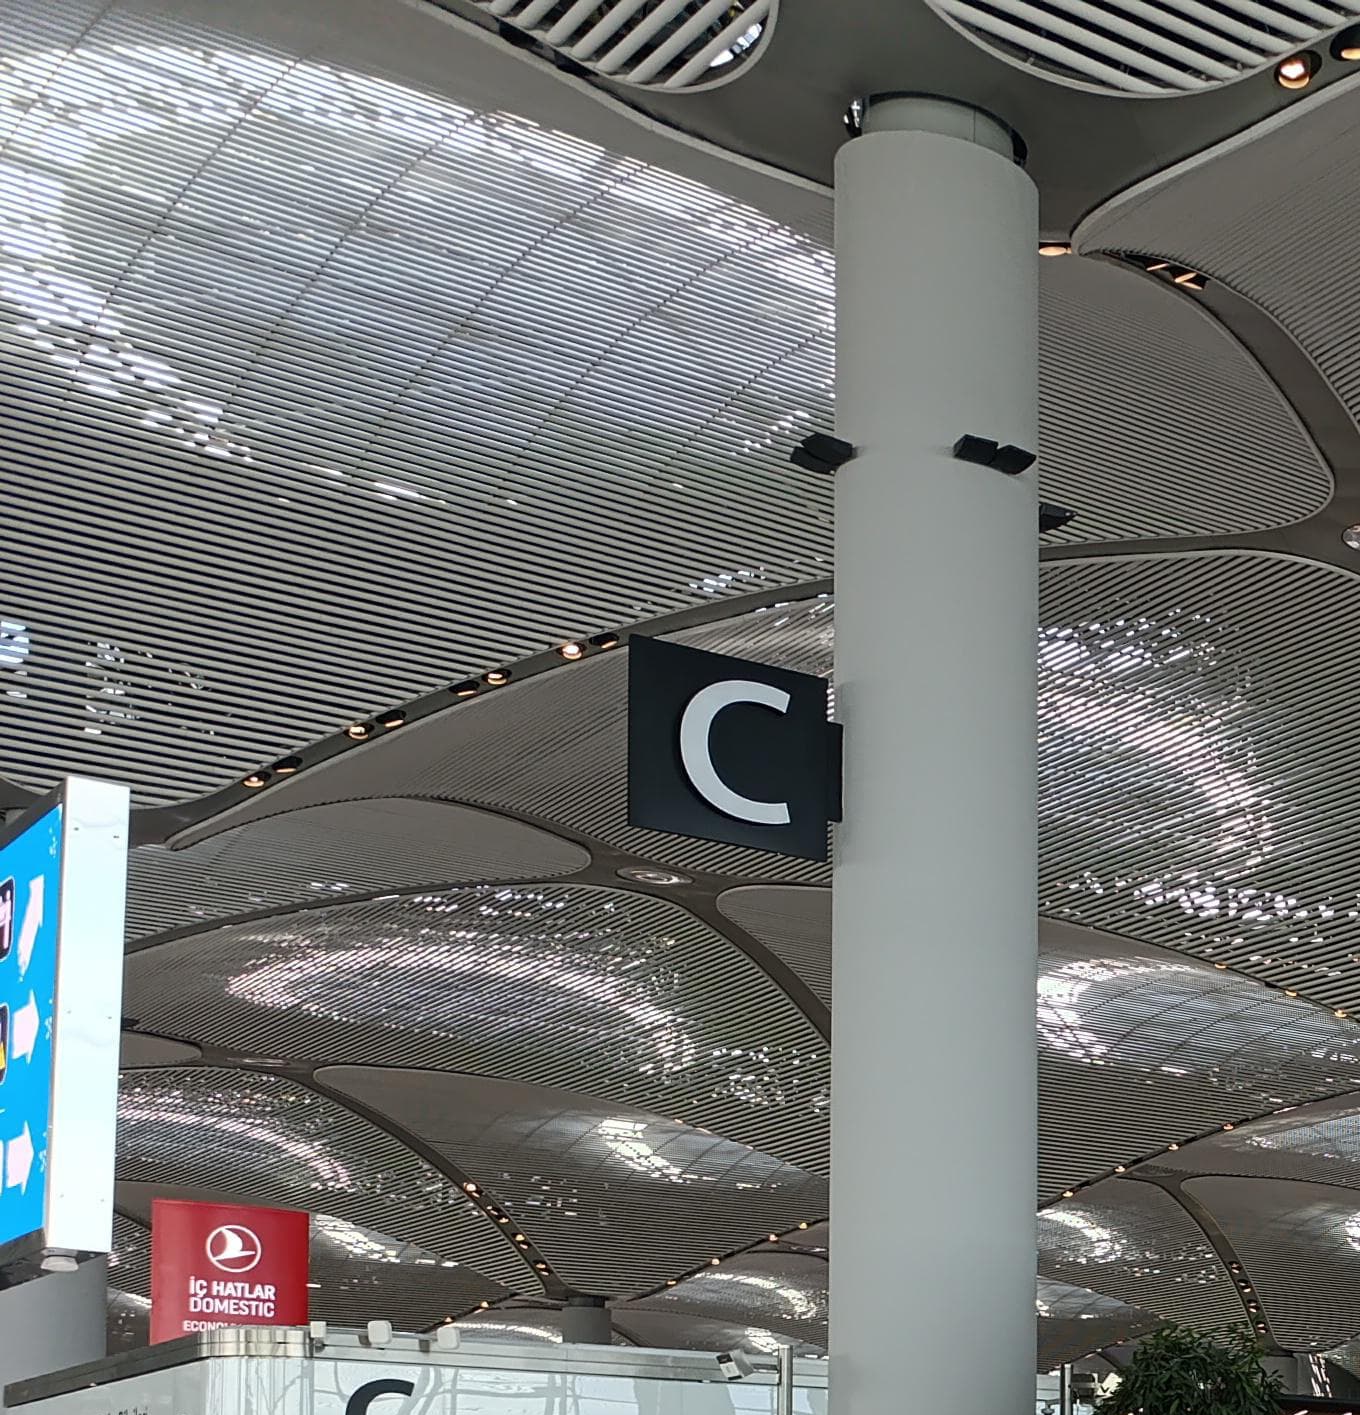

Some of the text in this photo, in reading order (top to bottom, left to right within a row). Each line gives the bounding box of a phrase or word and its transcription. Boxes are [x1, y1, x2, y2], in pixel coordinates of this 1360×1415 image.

[680, 679, 791, 825] C
[189, 1276, 276, 1300] İÇ HATLAR
[189, 1298, 275, 1318] DOMESTIC
